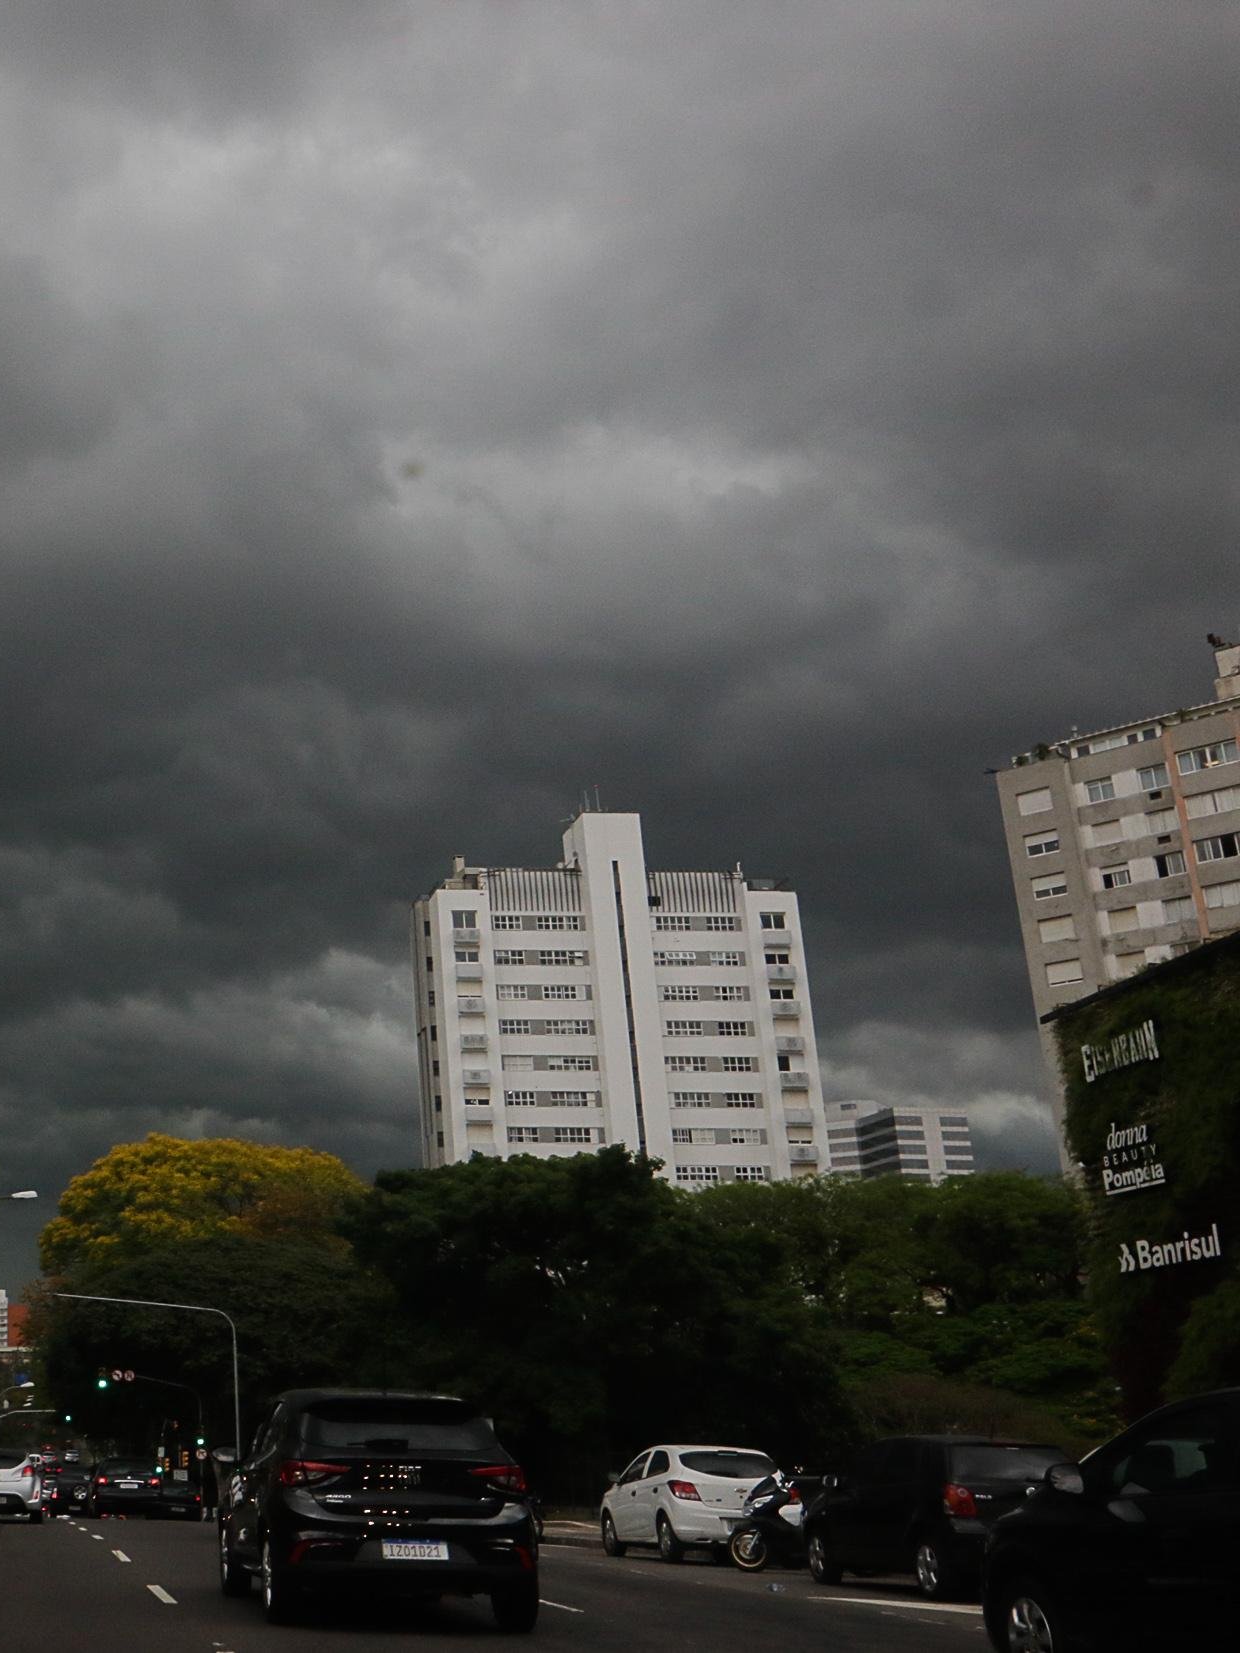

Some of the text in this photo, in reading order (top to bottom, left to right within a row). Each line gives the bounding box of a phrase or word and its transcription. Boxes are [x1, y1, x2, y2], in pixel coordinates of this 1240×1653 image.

[1106, 1121, 1148, 1151] donna
[1103, 1143, 1157, 1168] BEAUTY
[1102, 1158, 1165, 1191] Pompéia
[1135, 1222, 1221, 1270] Banrisul
